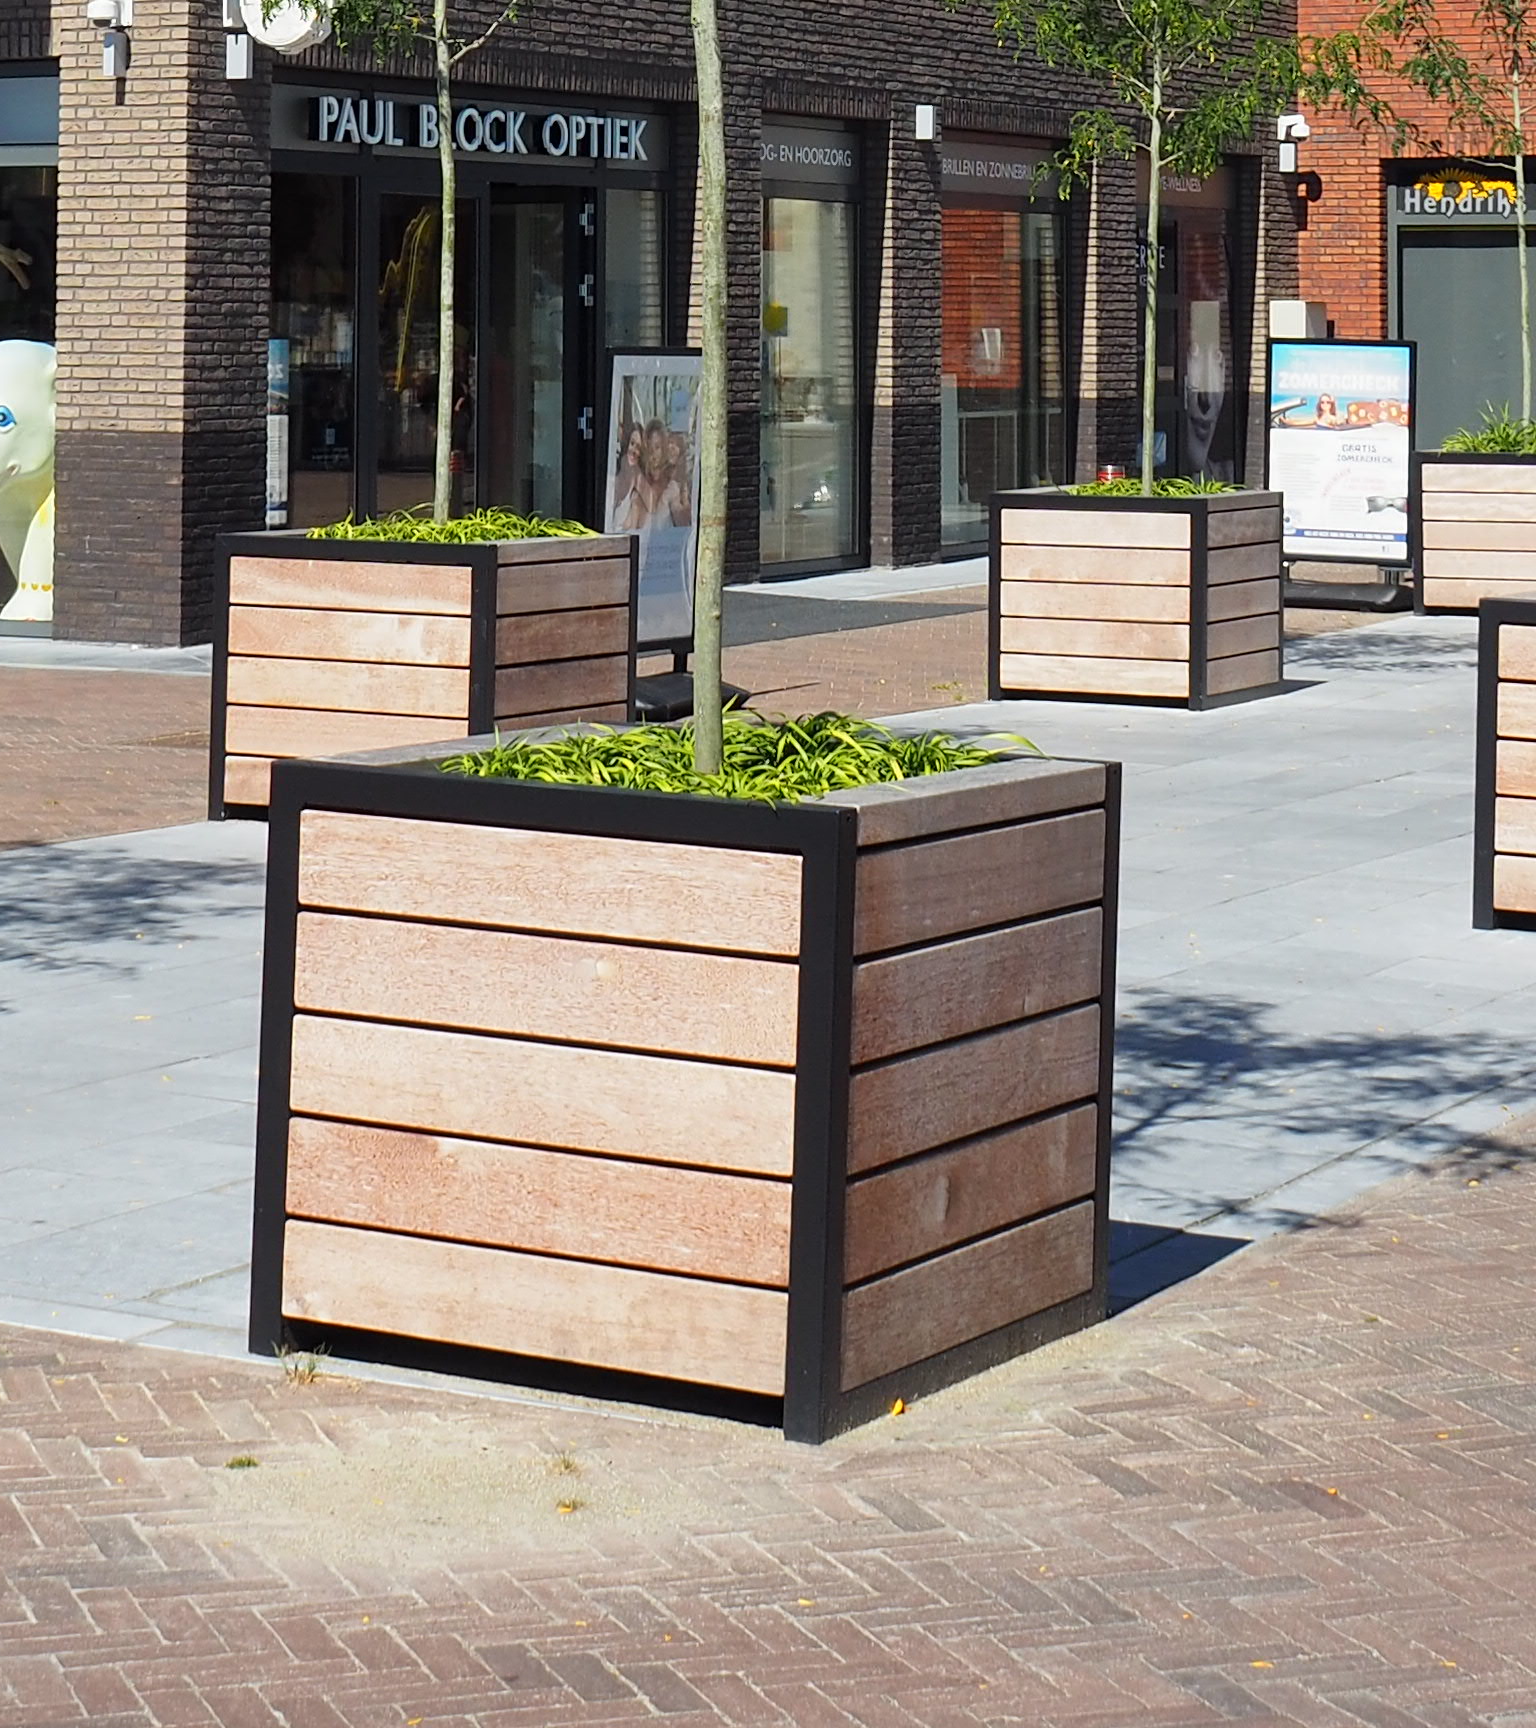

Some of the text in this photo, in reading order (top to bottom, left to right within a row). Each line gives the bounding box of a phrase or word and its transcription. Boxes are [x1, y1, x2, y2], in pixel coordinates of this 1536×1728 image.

[318, 95, 404, 147] PAUL
[542, 113, 649, 161] OPTIEK
[779, 144, 794, 162] EN
[794, 146, 853, 167] HOORZORG
[942, 158, 975, 176] BRILLEN
[975, 160, 988, 177] EN
[1277, 371, 1402, 392] ZOMERCHECK
